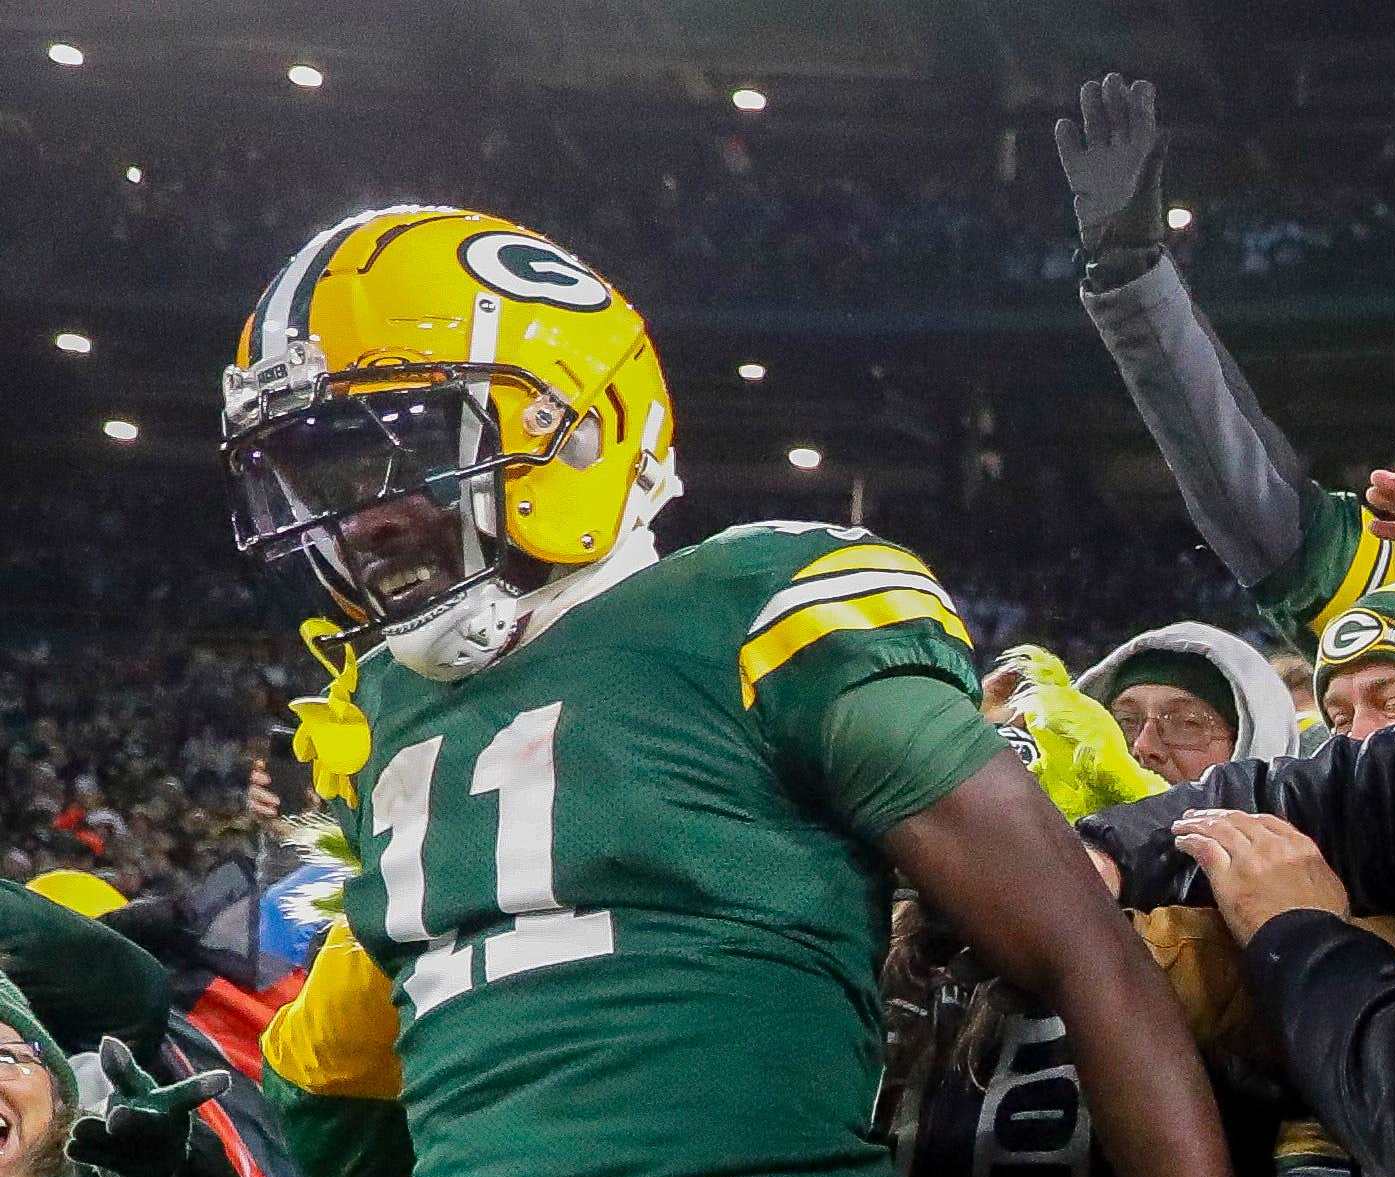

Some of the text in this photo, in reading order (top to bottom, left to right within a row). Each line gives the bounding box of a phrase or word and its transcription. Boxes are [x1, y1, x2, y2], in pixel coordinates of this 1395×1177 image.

[463, 232, 609, 308] G
[1322, 612, 1384, 659] G
[371, 700, 614, 1021] 11
